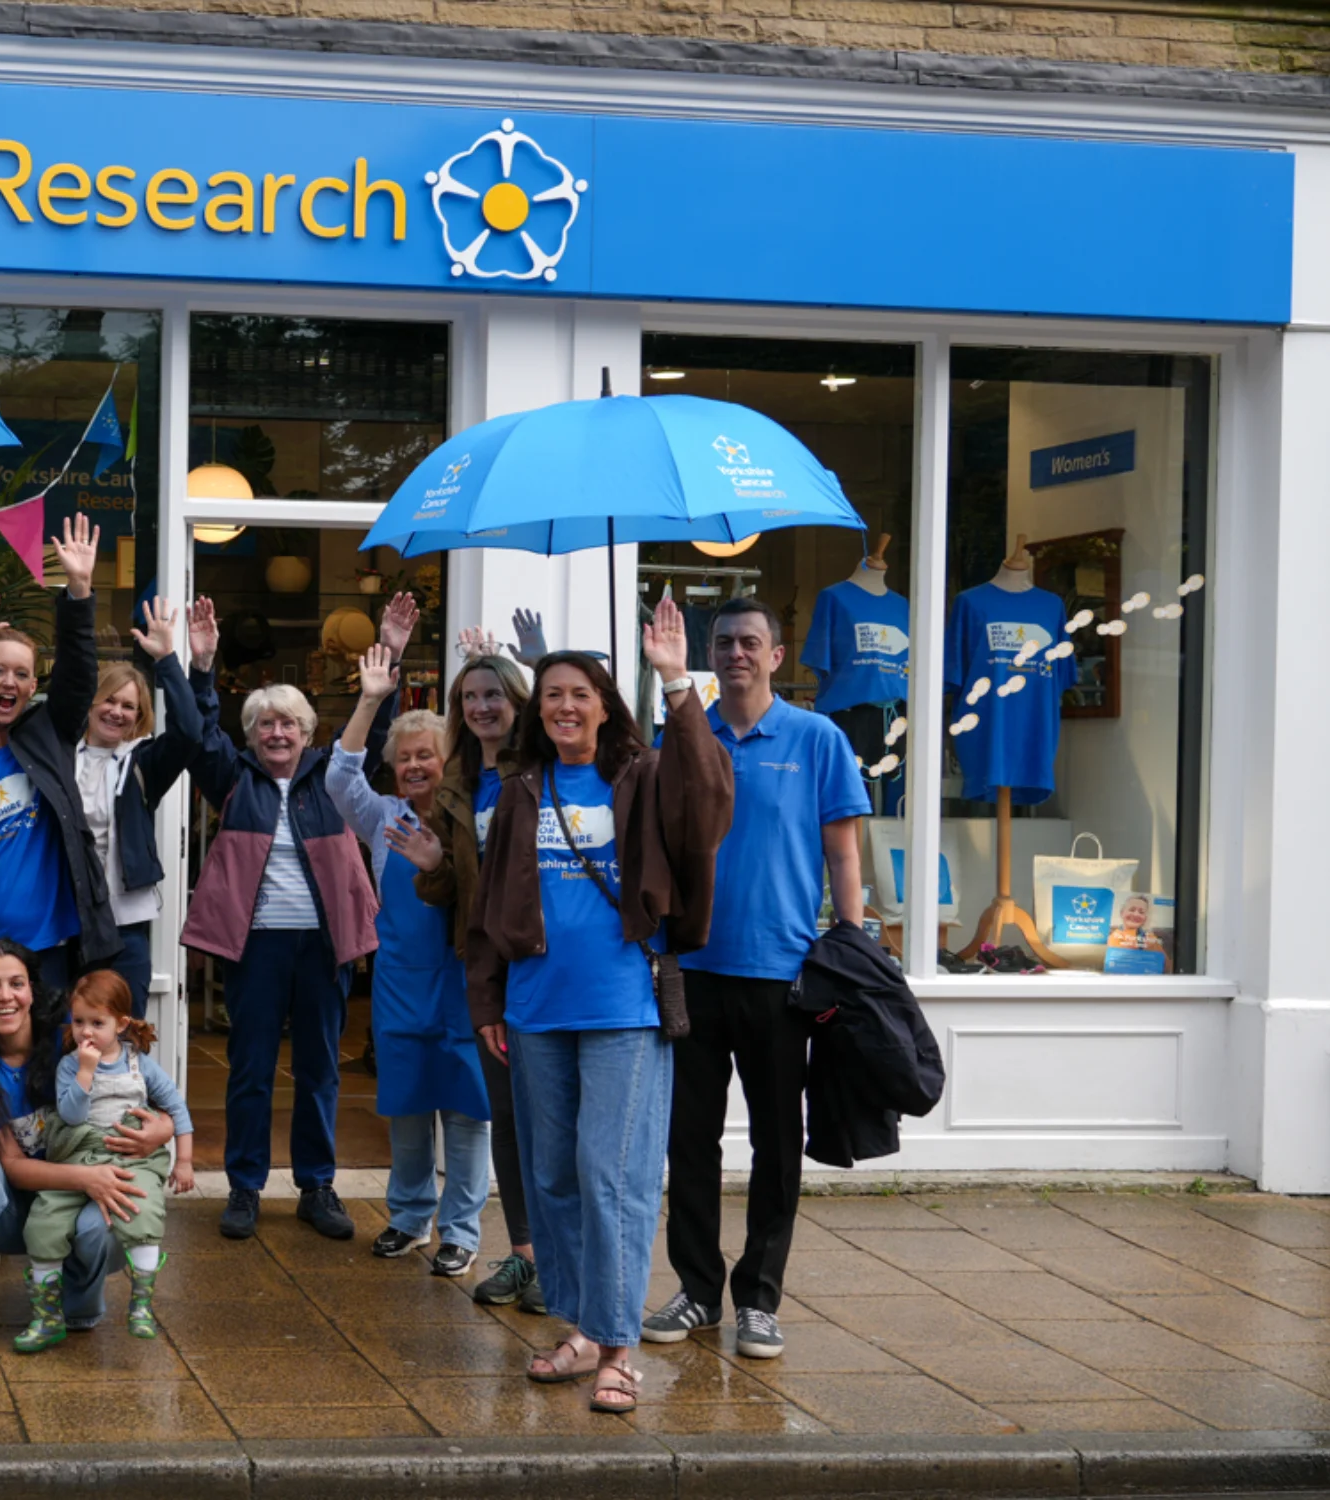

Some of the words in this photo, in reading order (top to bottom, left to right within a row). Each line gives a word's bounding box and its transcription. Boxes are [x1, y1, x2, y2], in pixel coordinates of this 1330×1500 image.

[1051, 446, 1111, 476] Women's
[716, 465, 775, 477] Yorkshire
[730, 477, 774, 488] Cancer
[424, 485, 462, 498] Yorkshire
[538, 826, 555, 834] OR
[1064, 914, 1105, 924] Yorkshire
[1070, 923, 1100, 932] Cancer
